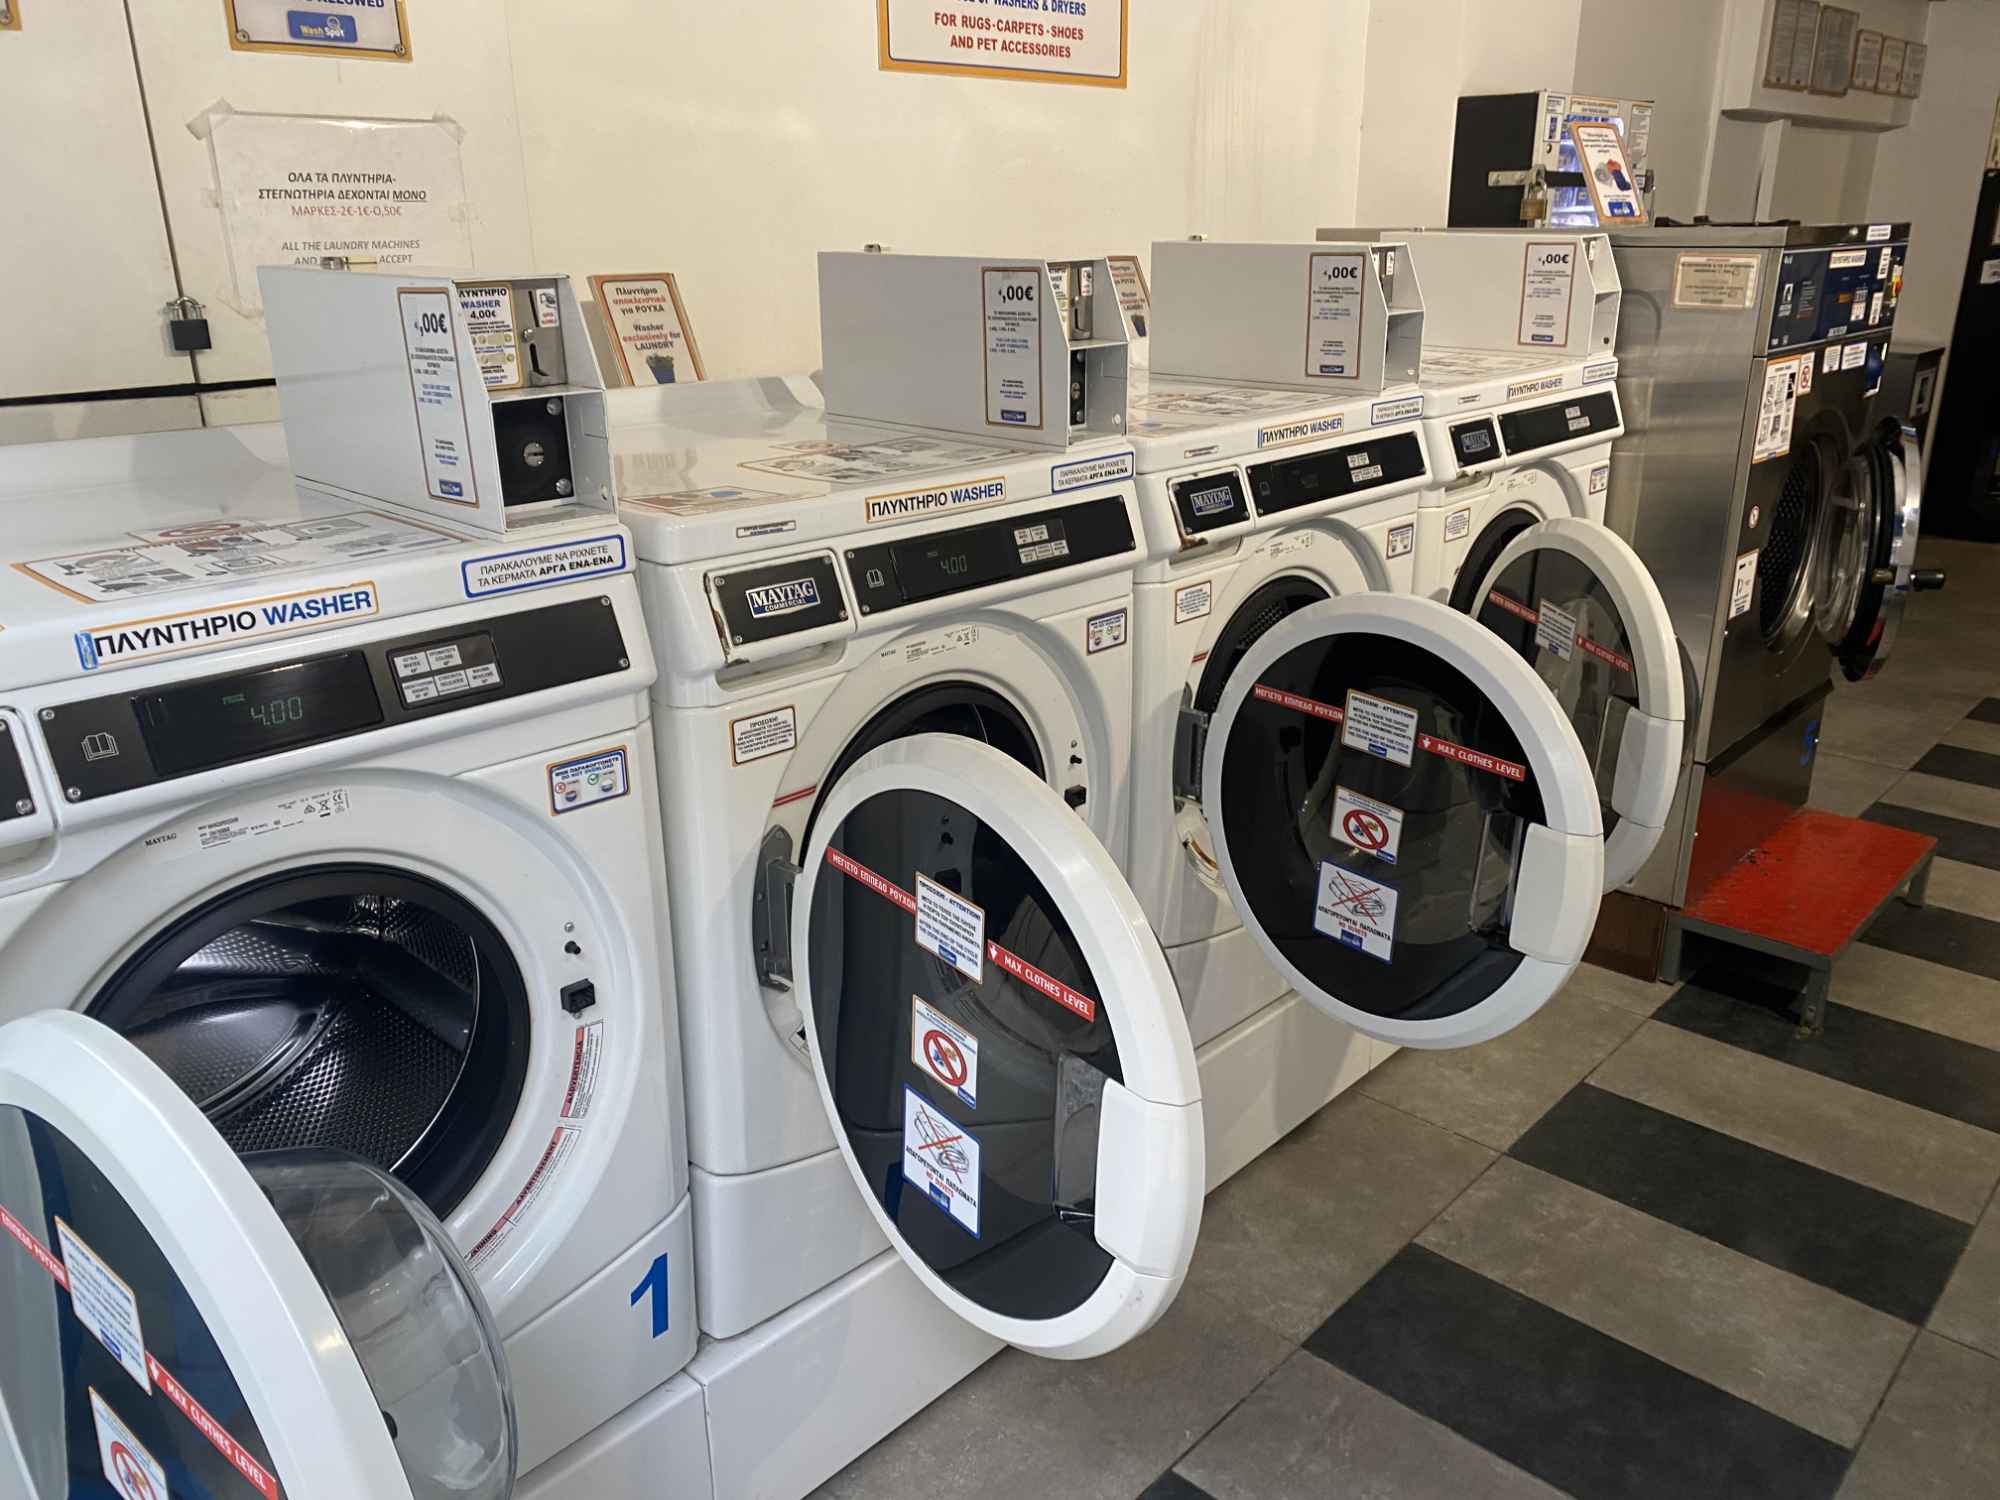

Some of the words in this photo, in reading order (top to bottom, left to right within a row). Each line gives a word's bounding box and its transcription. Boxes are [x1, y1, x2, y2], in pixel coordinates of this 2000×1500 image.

[1051, 1, 1086, 16] DRYERS
[934, 12, 957, 27] FOR
[950, 34, 974, 49] AND
[977, 37, 998, 51] PET
[1001, 40, 1071, 58] ACCESSORIES
[287, 172, 313, 184] ΟΛΑ
[316, 173, 329, 184] ΤΑ
[258, 189, 335, 200] ΣΤΕΓΝΩΤΗΡΙΑ
[337, 190, 390, 200] ΔΕΧΟΝΤΑΙ
[392, 190, 427, 201] ΜΟΝΟ
[281, 241, 299, 251] ALL
[302, 241, 321, 250] THE
[323, 240, 369, 250] LAUNDRY
[371, 240, 421, 250] MACHINES
[294, 256, 318, 265] AND
[379, 254, 413, 264] ACCEPT
[1538, 254, 1570, 266] ,00€
[1324, 266, 1358, 281] ,00€
[459, 288, 507, 298] ΛΥΝΤΗΡΙΟ
[998, 286, 1034, 304] ,00€
[460, 299, 501, 309] WASHER
[470, 309, 497, 321] 4,00€
[414, 313, 448, 337] ,00€
[1262, 424, 1309, 443] ΠΛΥΝΤΗΡΙΟ
[1309, 417, 1342, 433] WASHER
[871, 493, 948, 518] ΠΛΥΝΤΗΡΙΟ
[950, 481, 1004, 504] WASHER
[1194, 489, 1230, 508] MAYTAG
[480, 553, 553, 576] ΠΑΡΑΚΑΛΟΥΜΕ
[555, 551, 569, 562] ΝΑ
[570, 544, 609, 559] ΡΙΧΝΕΤΕ
[477, 578, 491, 587] ΤΑ
[491, 569, 537, 586] ΚΕΡΜΑΤΑ
[539, 563, 567, 576] ΑΡΓΑ
[569, 555, 615, 570] ΕΝΑ-ΕΝΑ
[751, 581, 815, 608] MAYTAG
[764, 597, 807, 612] COMMERCIAL
[94, 610, 257, 658] ΠΛΥΝΤΗΡΙΟ
[261, 589, 372, 627] WASHER
[250, 696, 303, 726] 4.00
[1437, 743, 1456, 757] MAX
[1457, 751, 1493, 769] CLOTHES
[1495, 762, 1521, 778] LEVEL
[144, 832, 177, 847] MAYTAG
[1004, 954, 1022, 975] MAX
[1024, 968, 1060, 998] CLOTHES
[1063, 990, 1090, 1016] LEVEL
[630, 1251, 669, 1339] 1
[166, 1379, 188, 1411] MAX
[190, 1404, 232, 1456] CLOTHES
[234, 1448, 267, 1491] LEVEL
